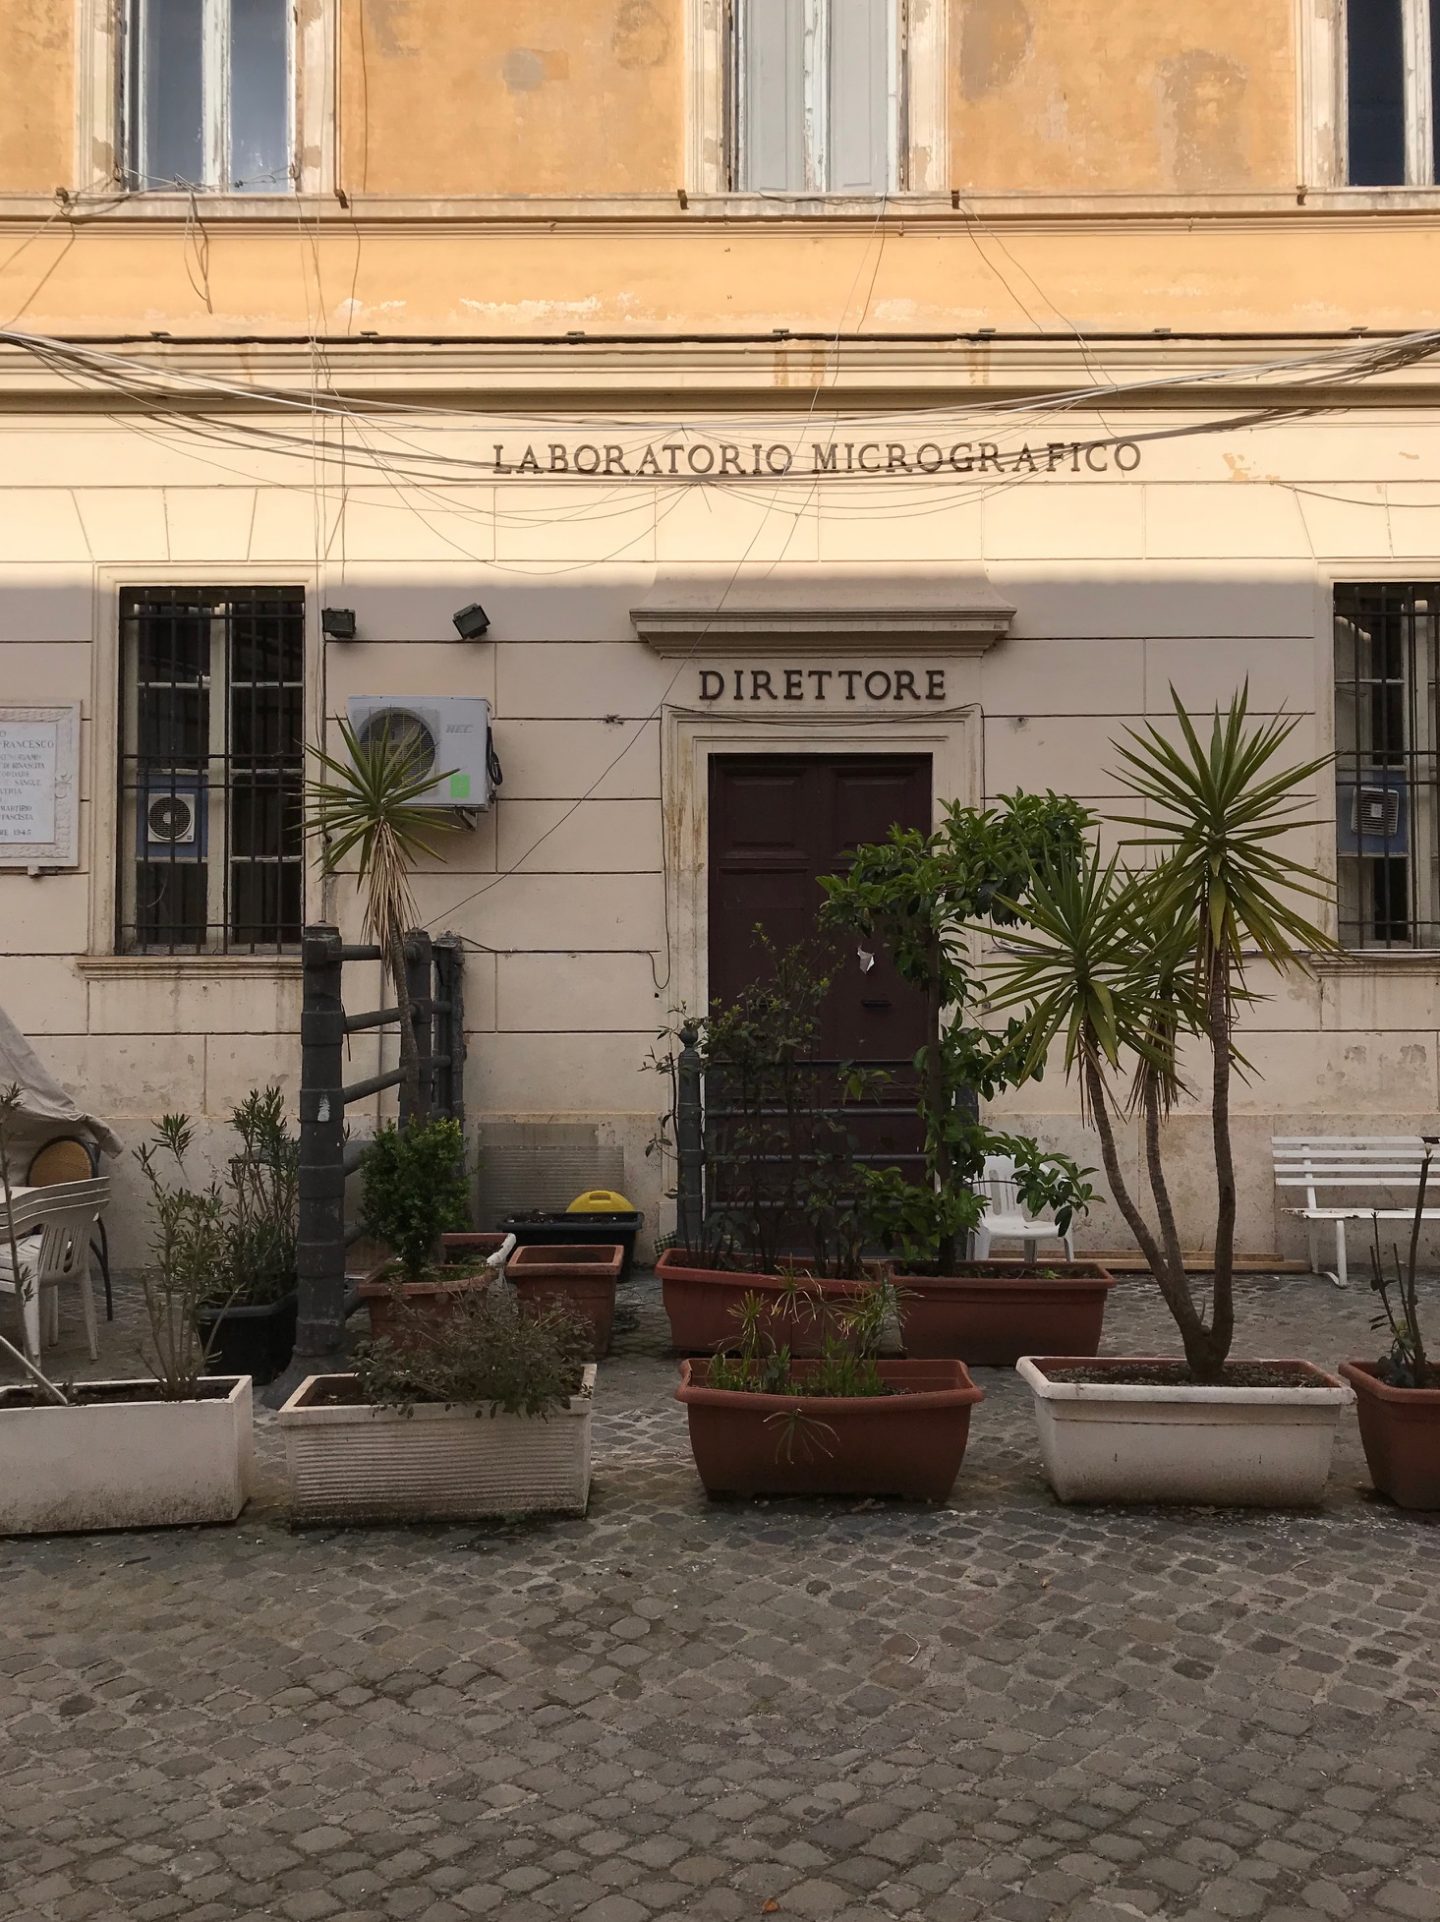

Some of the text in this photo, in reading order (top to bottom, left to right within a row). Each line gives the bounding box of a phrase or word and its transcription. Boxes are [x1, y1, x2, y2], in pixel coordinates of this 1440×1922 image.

[492, 442, 1142, 475] LABORATORIO MICROGRAFICO
[699, 669, 946, 701] DIRETTORE
